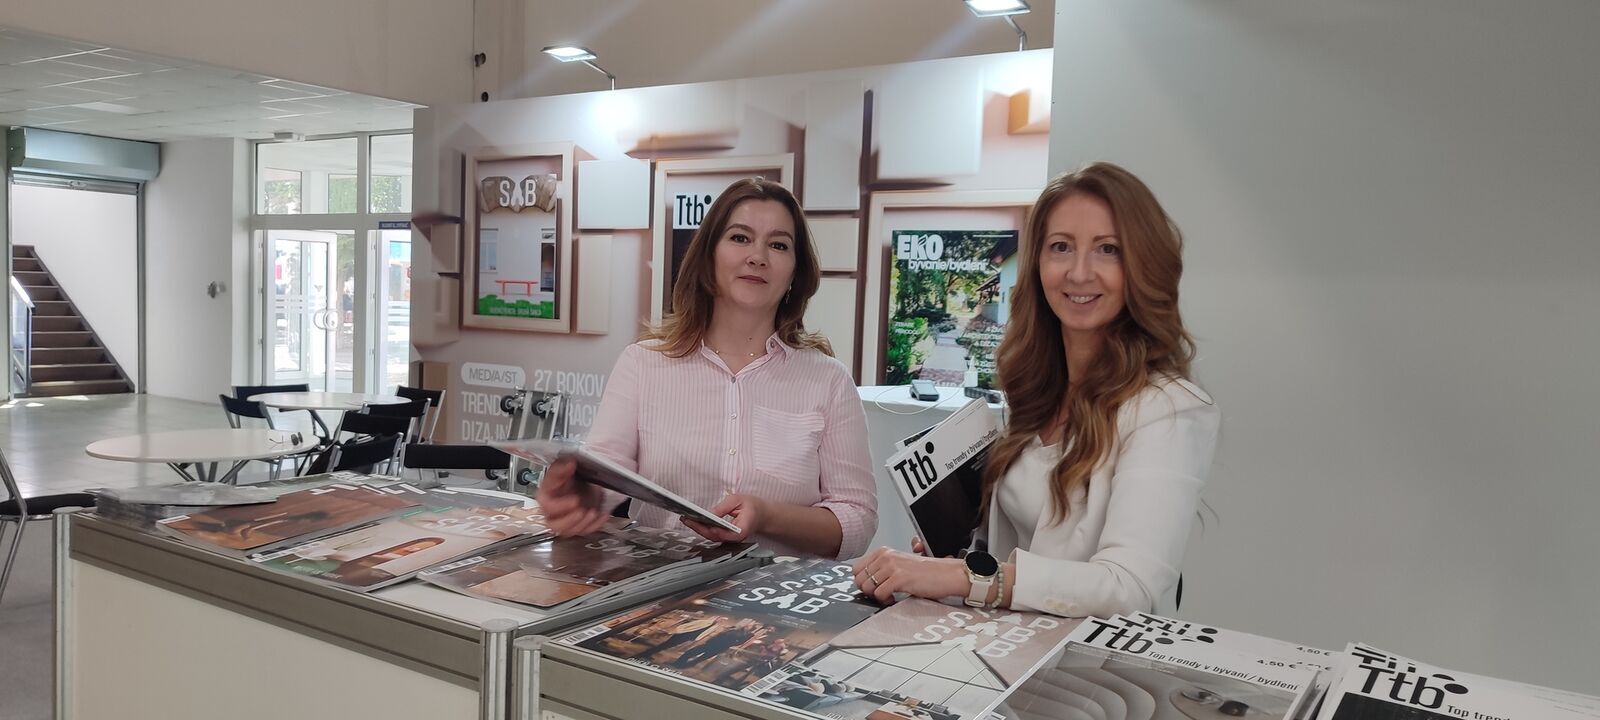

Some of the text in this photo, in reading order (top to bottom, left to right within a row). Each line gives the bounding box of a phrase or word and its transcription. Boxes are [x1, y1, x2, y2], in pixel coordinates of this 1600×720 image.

[676, 195, 704, 226] Ttb
[897, 234, 943, 260] EKO
[534, 369, 552, 392] 27
[894, 450, 937, 498] Ttb
[1083, 619, 1154, 655] Ttb
[1149, 651, 1166, 661] Top
[1168, 655, 1202, 669] trendy
[1358, 664, 1445, 710] Ttb
[1447, 705, 1470, 717] Top
